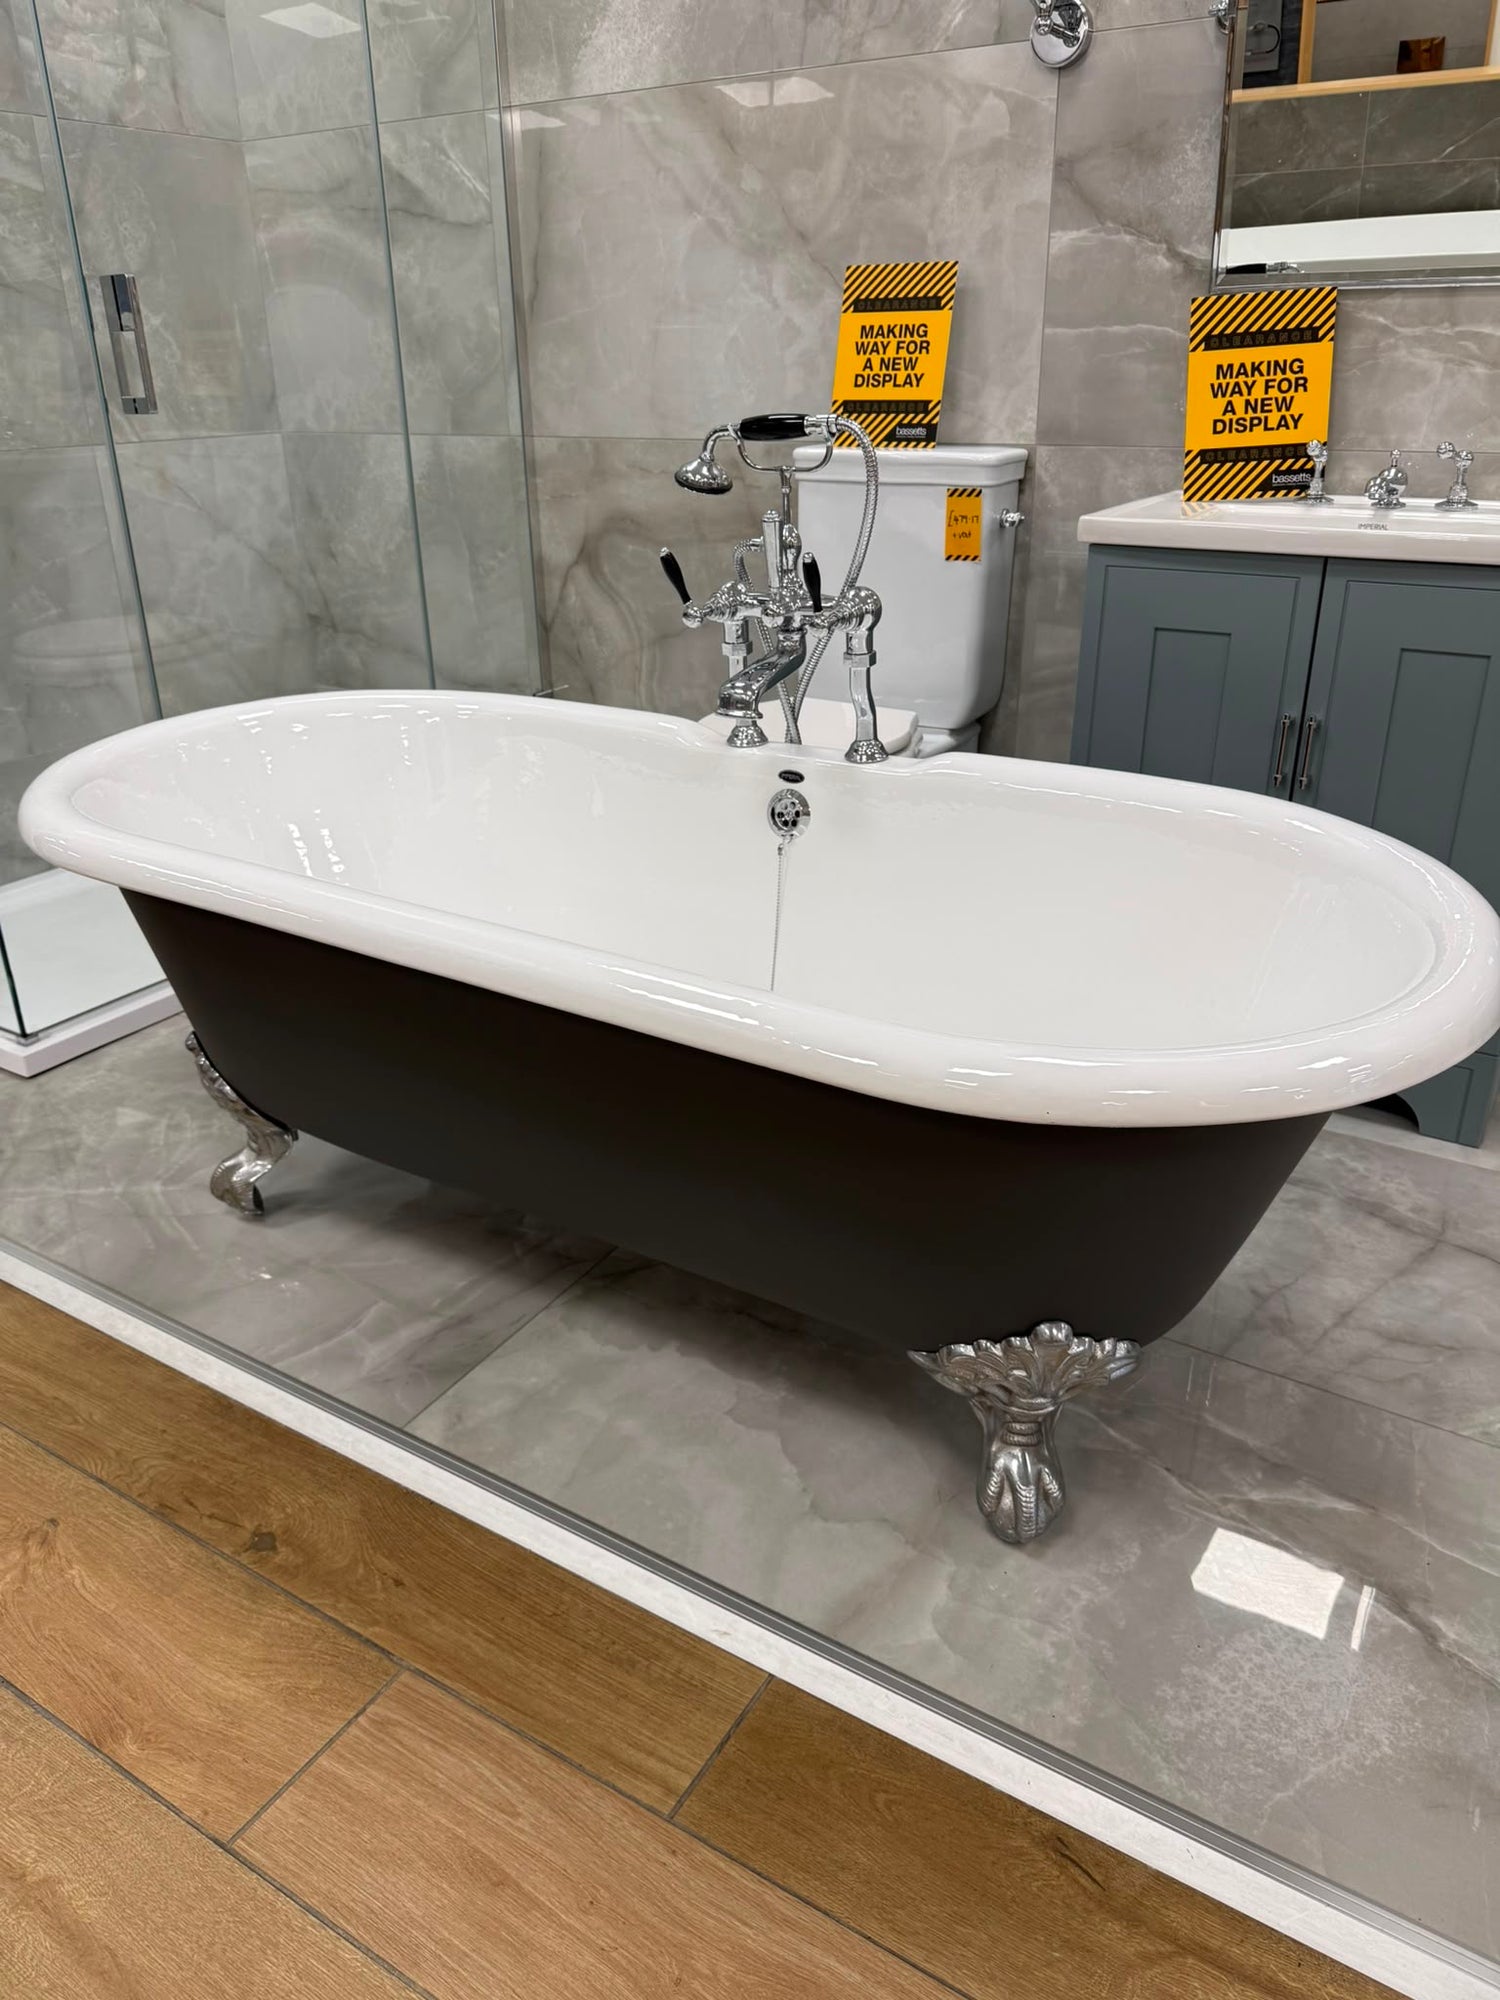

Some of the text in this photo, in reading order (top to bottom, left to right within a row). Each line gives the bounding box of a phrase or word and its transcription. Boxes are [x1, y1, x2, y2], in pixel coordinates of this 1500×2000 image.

[858, 299, 937, 311] CLEARANCE
[860, 323, 928, 339] MAKING
[1210, 330, 1313, 348] CLEARANCE
[855, 340, 930, 355] WAY FOR
[862, 356, 918, 371] A NEW
[1216, 358, 1304, 380] MAKING
[854, 373, 924, 388] DISPLAY
[1210, 376, 1308, 399] WAY FOR
[847, 402, 925, 412] CLEARANCE
[1222, 395, 1295, 416] A NEW
[896, 427, 927, 436] bassetts
[1212, 413, 1304, 435] DISPLAY
[1205, 446, 1306, 461] CLEARANCE
[1272, 472, 1312, 484] bassetts
